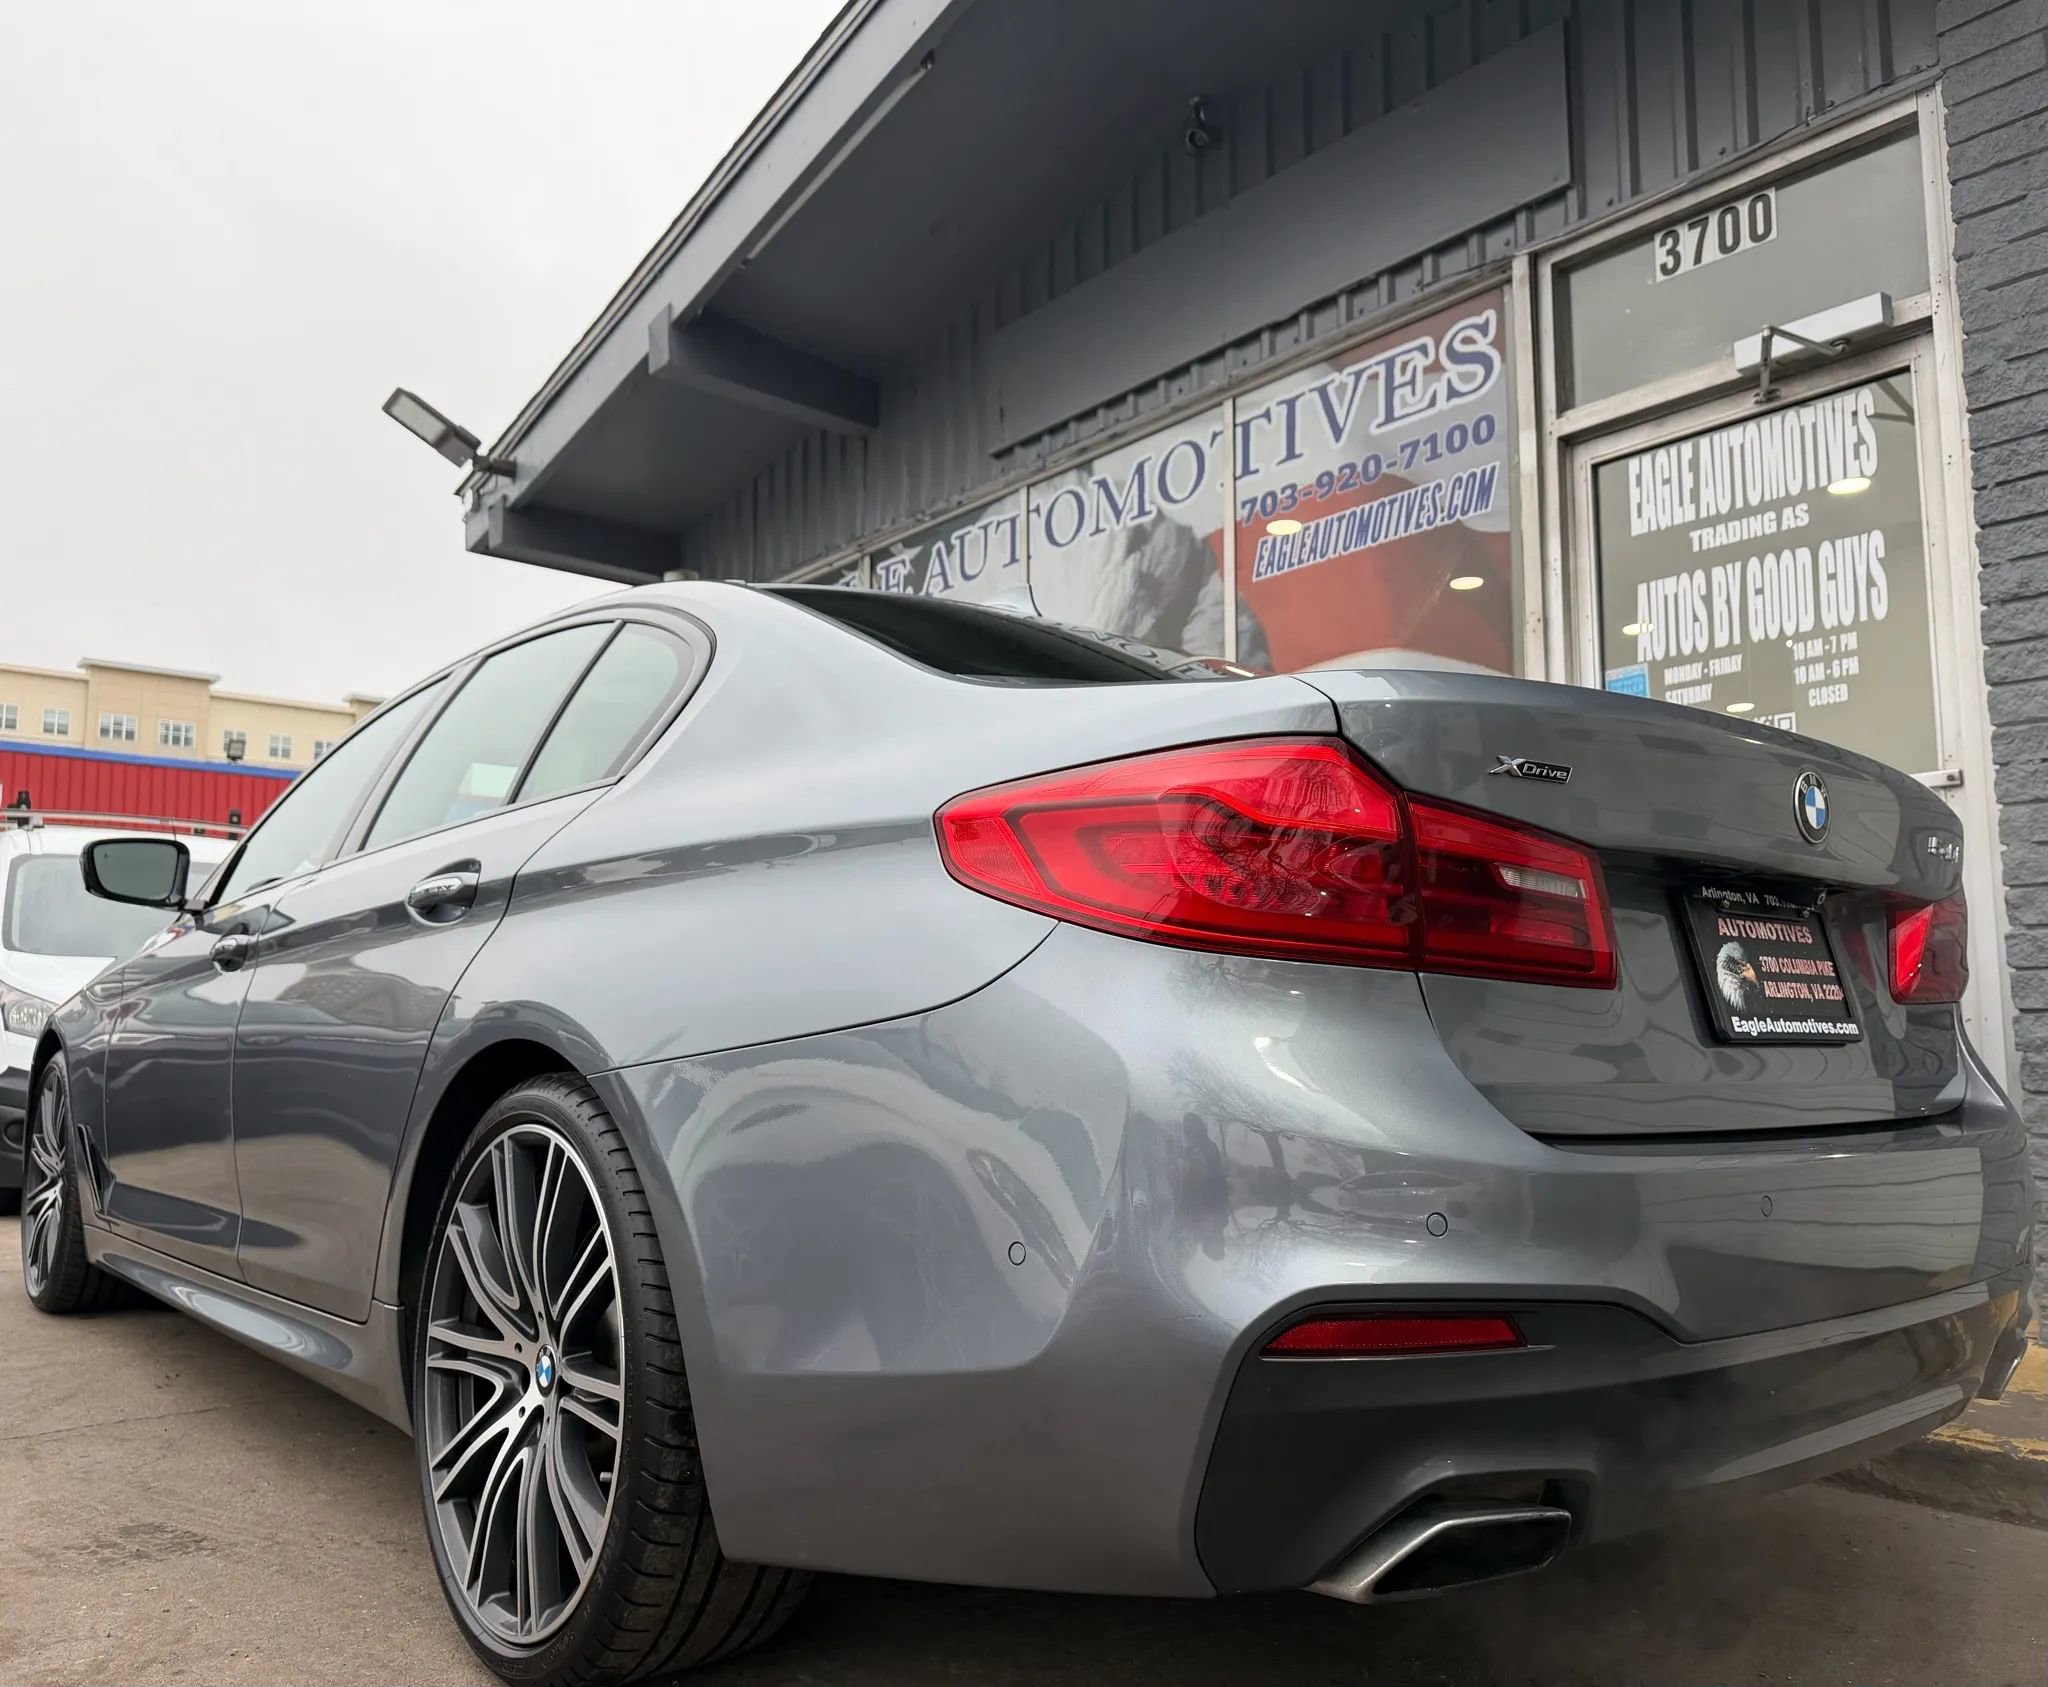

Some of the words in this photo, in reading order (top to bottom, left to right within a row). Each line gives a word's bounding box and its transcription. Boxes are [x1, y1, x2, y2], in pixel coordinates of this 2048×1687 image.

[1659, 193, 1773, 277] 3700
[921, 310, 1499, 597] AUTOMOTIVES
[1241, 413, 1496, 524] 703-920-7100
[1628, 443, 1697, 536] EAGLE
[1699, 388, 1878, 518] AUTOMOTIVES
[1253, 464, 1498, 581] EAGLEAUTOMOTIVES.COM
[1690, 511, 1778, 552] TRADING
[1781, 502, 1810, 531] AS
[1637, 568, 1710, 662] AUTOS
[1711, 560, 1742, 649] BY
[1746, 546, 1815, 643] GOOD
[1818, 529, 1889, 630] GUYS
[1792, 641, 1806, 661] 10
[1806, 637, 1824, 659] AM
[1830, 634, 1837, 654] 7
[1840, 631, 1858, 652] PM
[1664, 661, 1703, 686] MONDAY
[1708, 654, 1743, 678] FRIDAY
[1793, 665, 1807, 685] 10
[1807, 661, 1825, 683] AM
[1832, 659, 1840, 678] 6
[1841, 655, 1859, 676] PM
[1665, 683, 1713, 705] SATURDAY
[1808, 683, 1849, 707] CLOSED
[1745, 891, 1760, 905] VA
[1718, 917, 1814, 944] AUTOMOTIVES
[1759, 955, 1780, 973] 3700
[1817, 960, 1836, 977] PIKE
[1763, 980, 1814, 1003] ARLINGTON,
[1811, 983, 1825, 999] VA
[1731, 1016, 1859, 1036] EagleAutomotives.com
